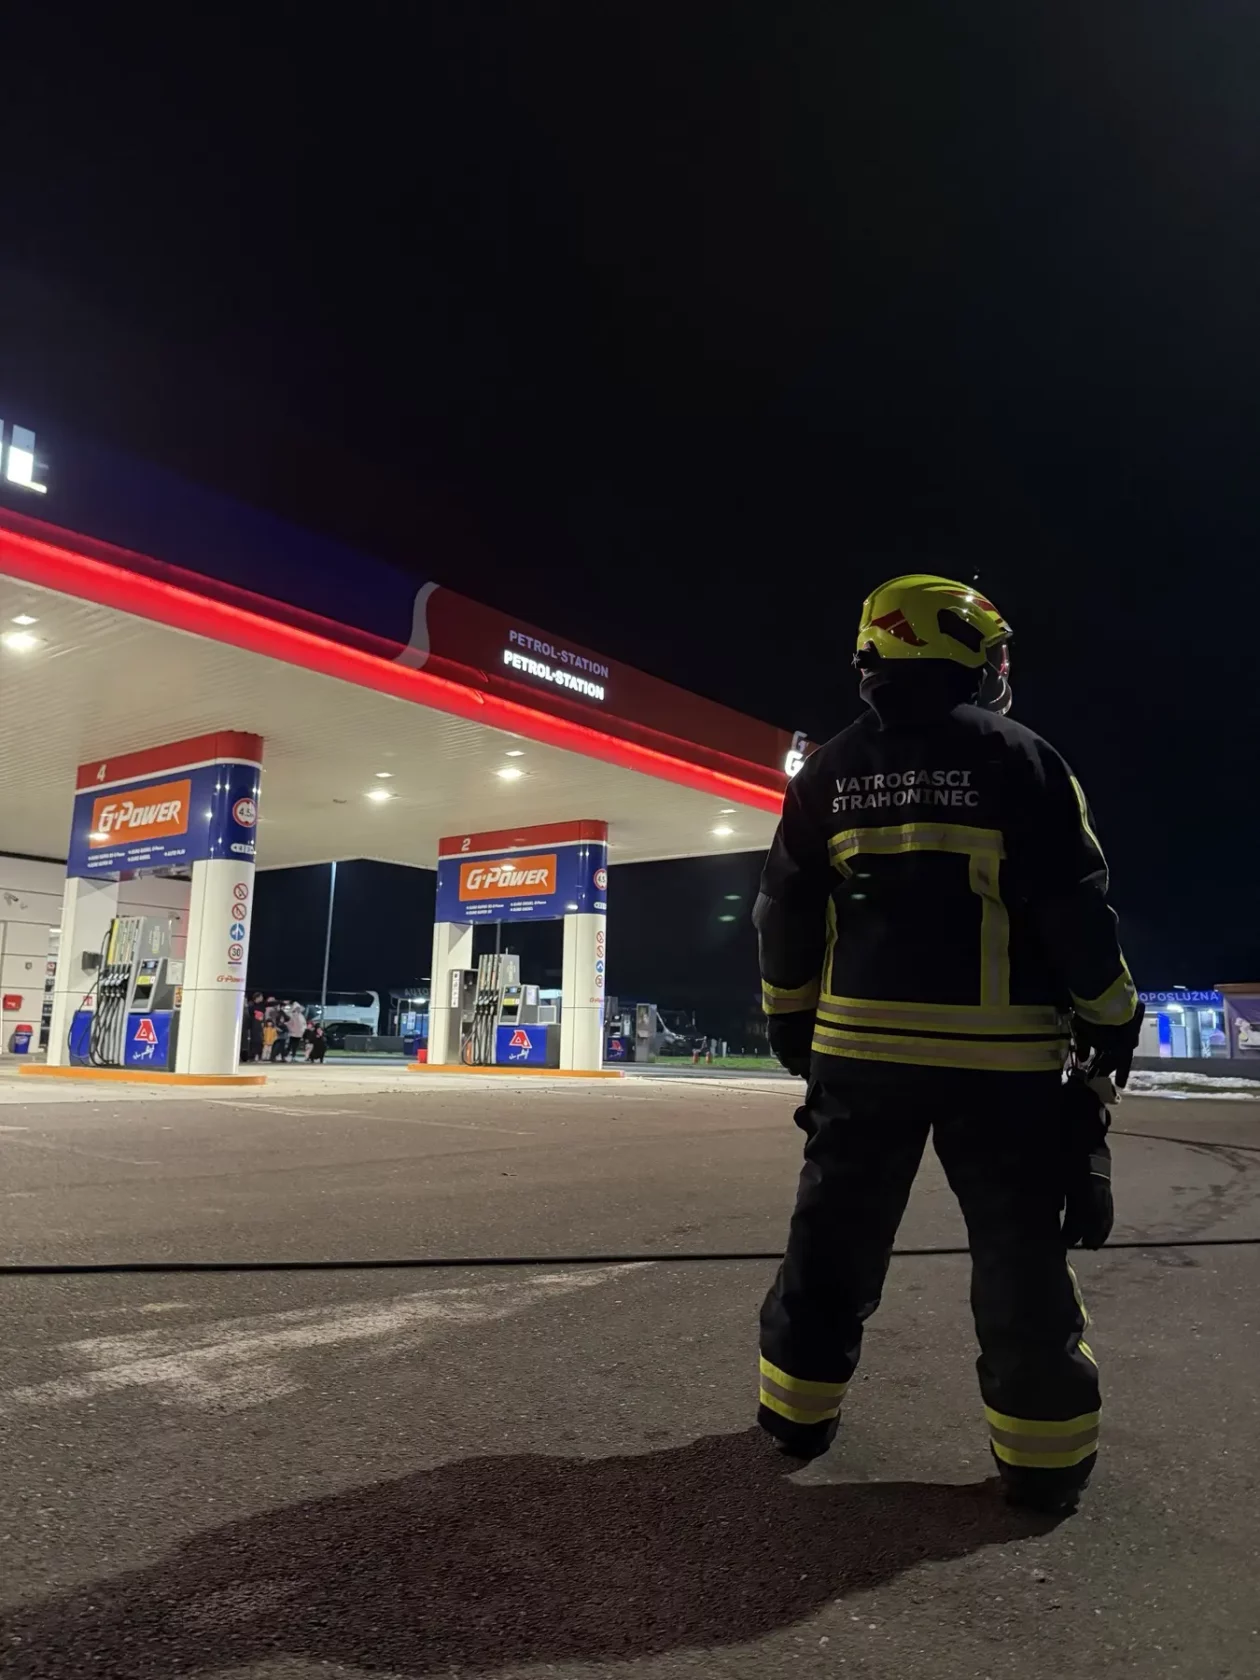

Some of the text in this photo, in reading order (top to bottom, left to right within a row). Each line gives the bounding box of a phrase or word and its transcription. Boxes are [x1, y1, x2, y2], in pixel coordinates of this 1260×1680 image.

[508, 629, 610, 679] PETROL-STATION
[503, 650, 605, 701] PETROL-STATION
[97, 764, 106, 782] 4
[835, 769, 972, 794] VATROGASCI
[832, 788, 980, 814] STRAHONINEC
[461, 838, 471, 851] 2
